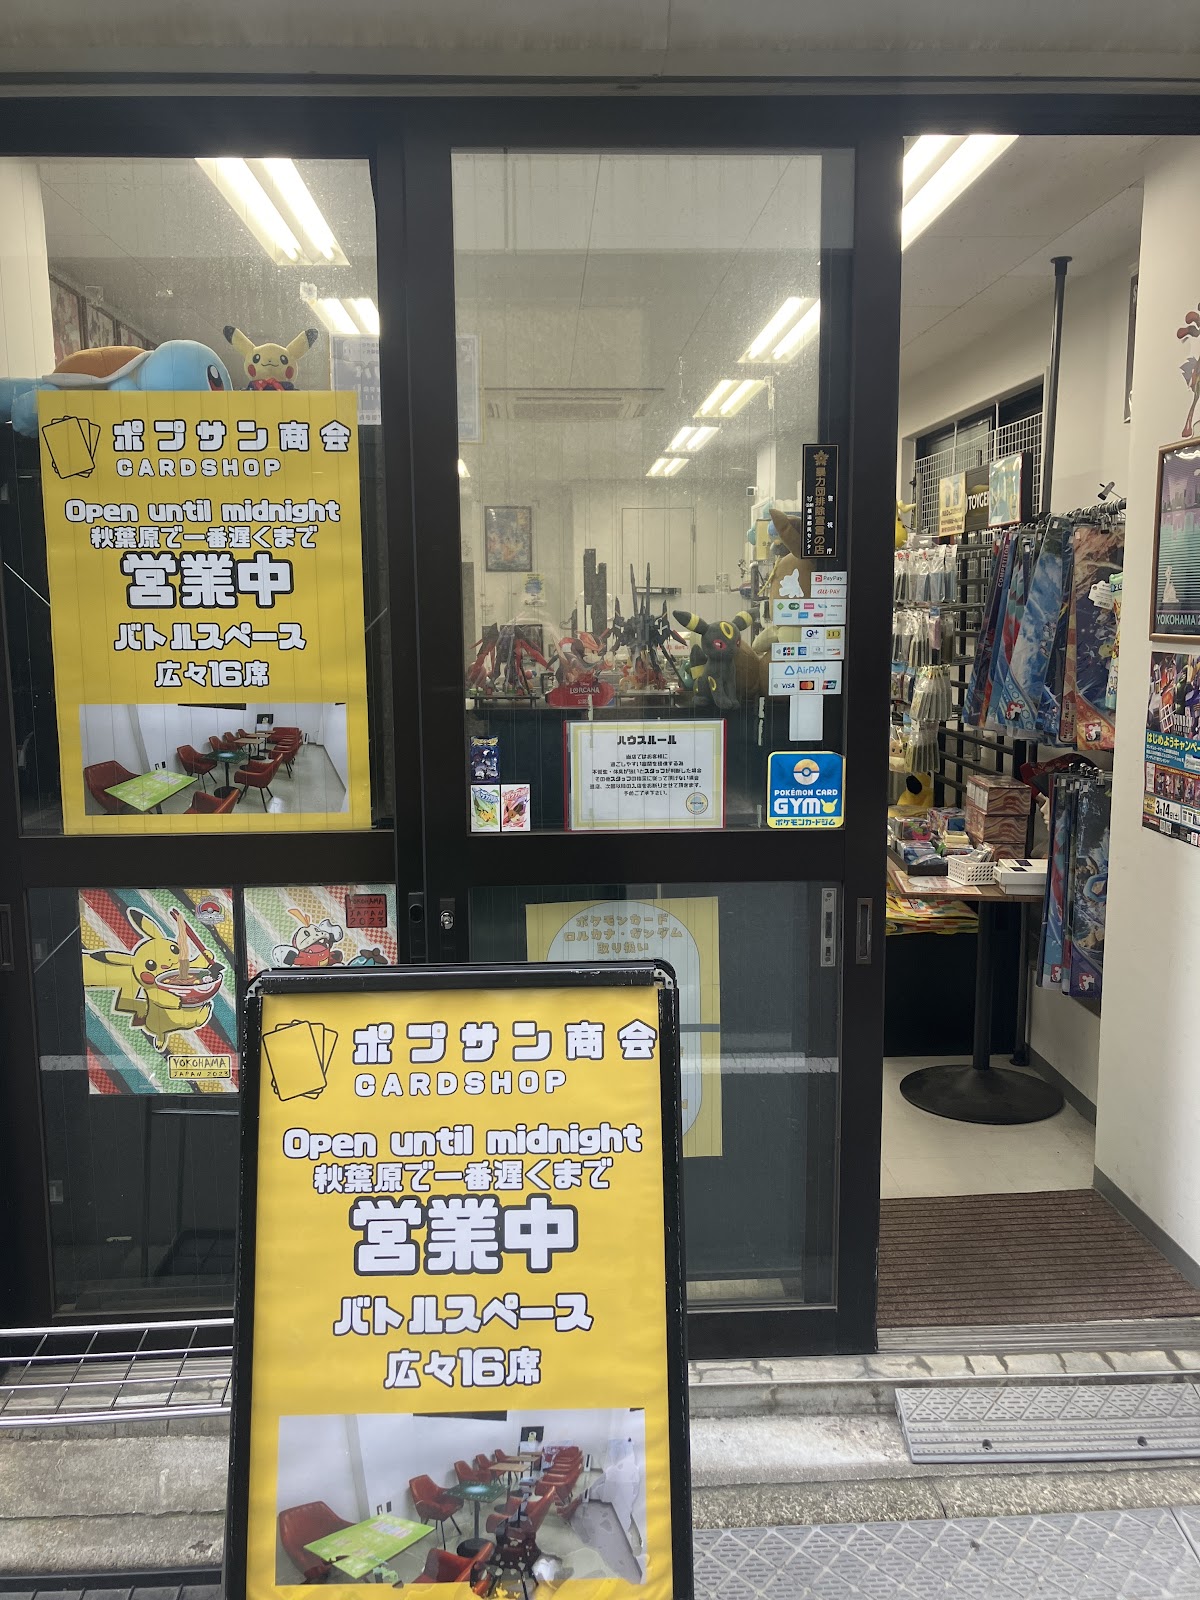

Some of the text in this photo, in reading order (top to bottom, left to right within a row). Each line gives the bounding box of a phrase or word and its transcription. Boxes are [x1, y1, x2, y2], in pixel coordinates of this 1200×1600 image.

[112, 419, 352, 453] ポプサン商会
[116, 458, 282, 477] CARDSHOP
[65, 499, 341, 525] Open until midnight
[90, 525, 318, 550] 秋葉原で一番遅くまで
[120, 552, 294, 609] 営業中
[1156, 614, 1196, 625] YOKOHAMA
[113, 623, 307, 651] バトルスペース
[154, 661, 270, 688] 広々16席
[796, 666, 827, 674] AirPAY
[616, 735, 677, 745] ハウスルール
[774, 788, 813, 796] POKÉMON
[774, 798, 820, 814] GYM
[775, 818, 836, 826] ポケモンカードジム
[348, 897, 384, 905] YOKOHAMA
[350, 917, 384, 925] 2023
[576, 913, 668, 927] ポケモンカード
[564, 927, 683, 941] ロルカナ・ガンダム
[597, 942, 649, 954] 取り扱い
[352, 1018, 658, 1064] ポプサン商会
[173, 1058, 227, 1068] YOKOHAMA
[354, 1071, 567, 1098] CARDSHOP
[283, 1123, 642, 1160] Open until midnight
[313, 1160, 611, 1193] 秋葉原で一番遅くまで
[349, 1194, 579, 1277] 営業中
[333, 1294, 594, 1335] バトルスペース
[383, 1348, 542, 1389] 広々16席
